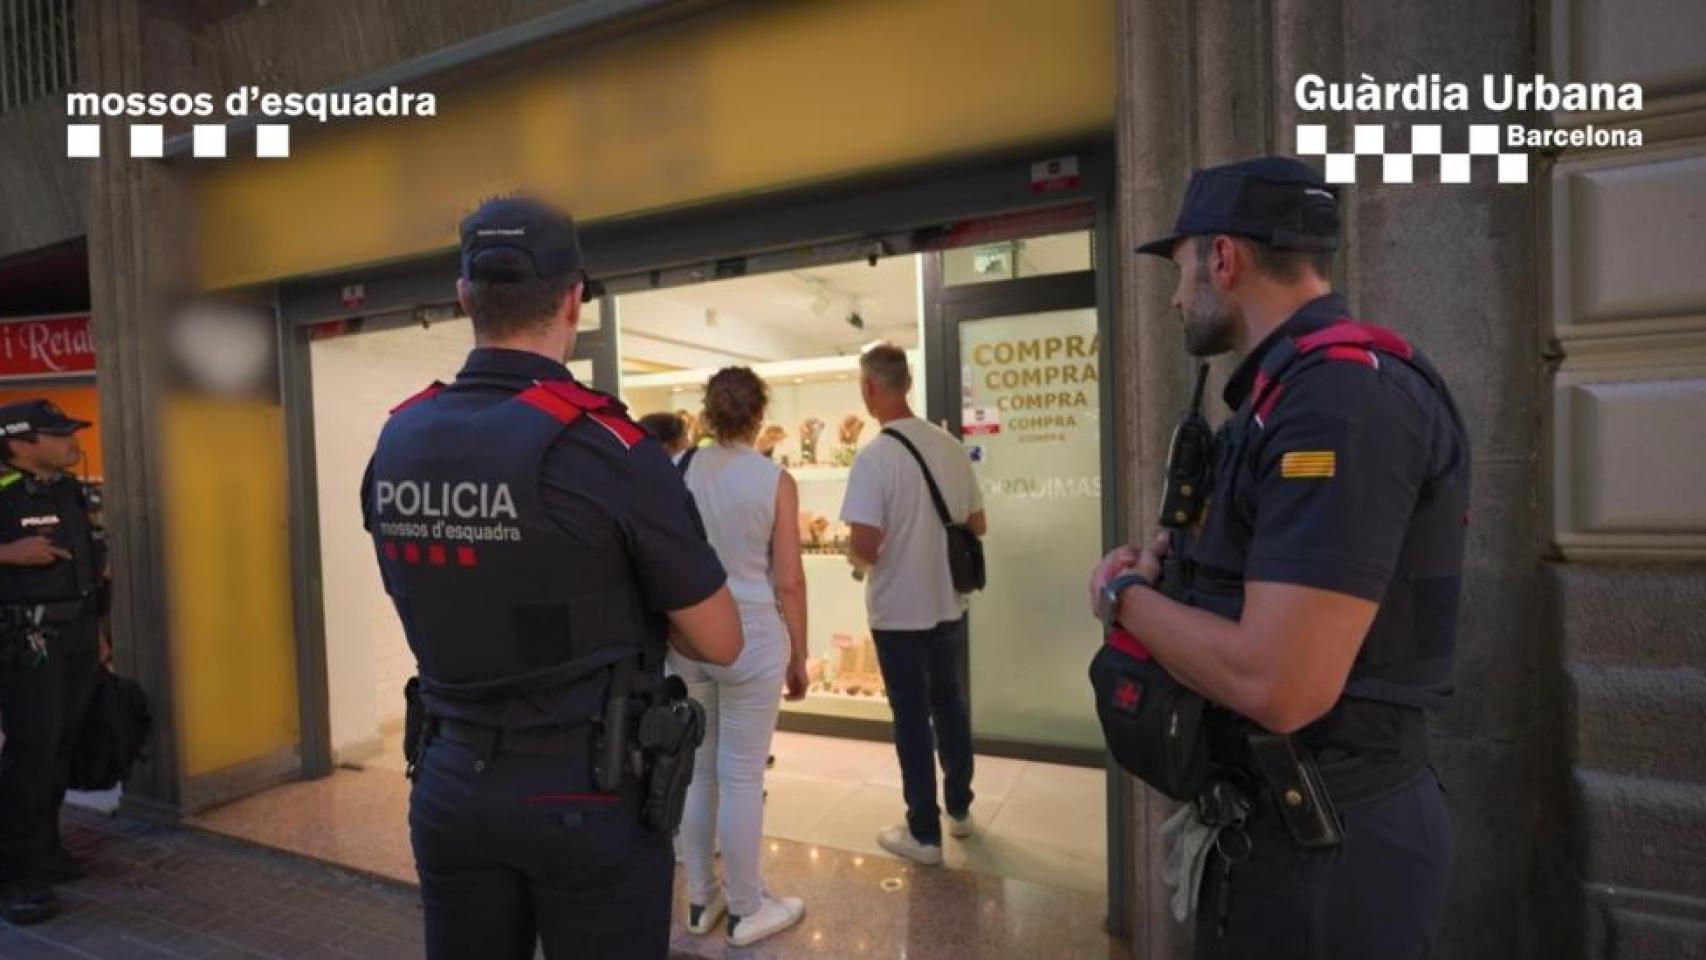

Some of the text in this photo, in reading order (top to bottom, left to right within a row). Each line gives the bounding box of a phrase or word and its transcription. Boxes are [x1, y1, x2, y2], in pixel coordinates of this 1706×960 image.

[985, 363, 1098, 390] COMPRA
[997, 391, 1087, 411] COMPRA
[1008, 416, 1076, 431] COMPRA
[376, 479, 518, 519] POLICIA
[380, 520, 521, 543] mossos d'esquadra
